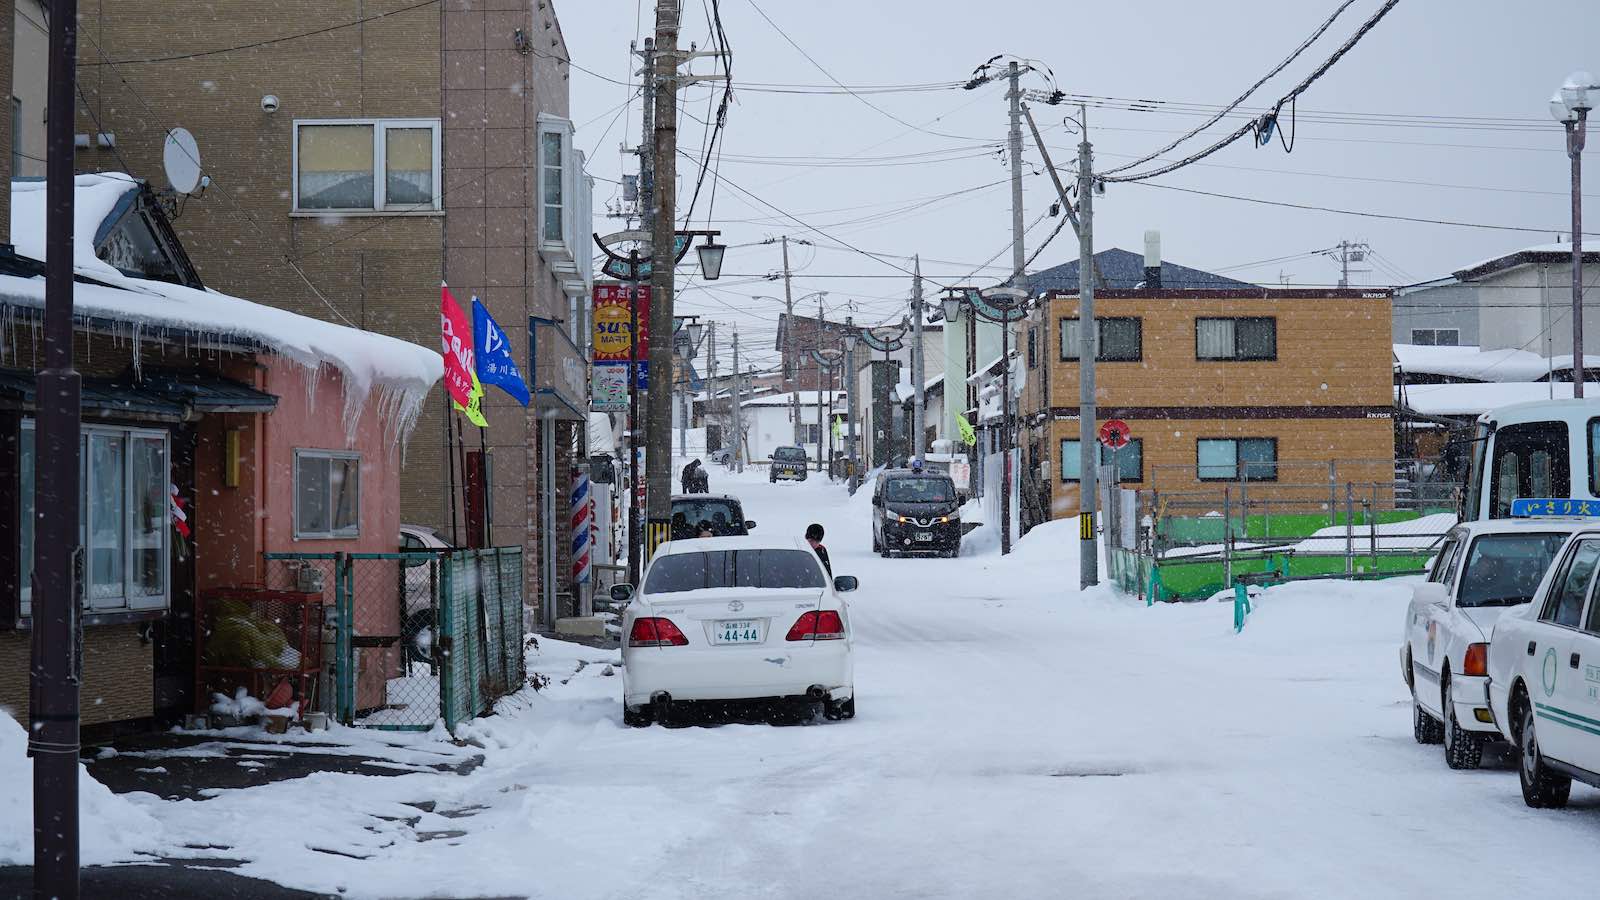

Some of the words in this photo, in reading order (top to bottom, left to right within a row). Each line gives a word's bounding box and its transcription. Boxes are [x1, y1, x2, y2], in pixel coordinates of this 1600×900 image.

[601, 335, 628, 344] MART
[1527, 501, 1592, 515] いさり火
[724, 629, 757, 642] 44-44
